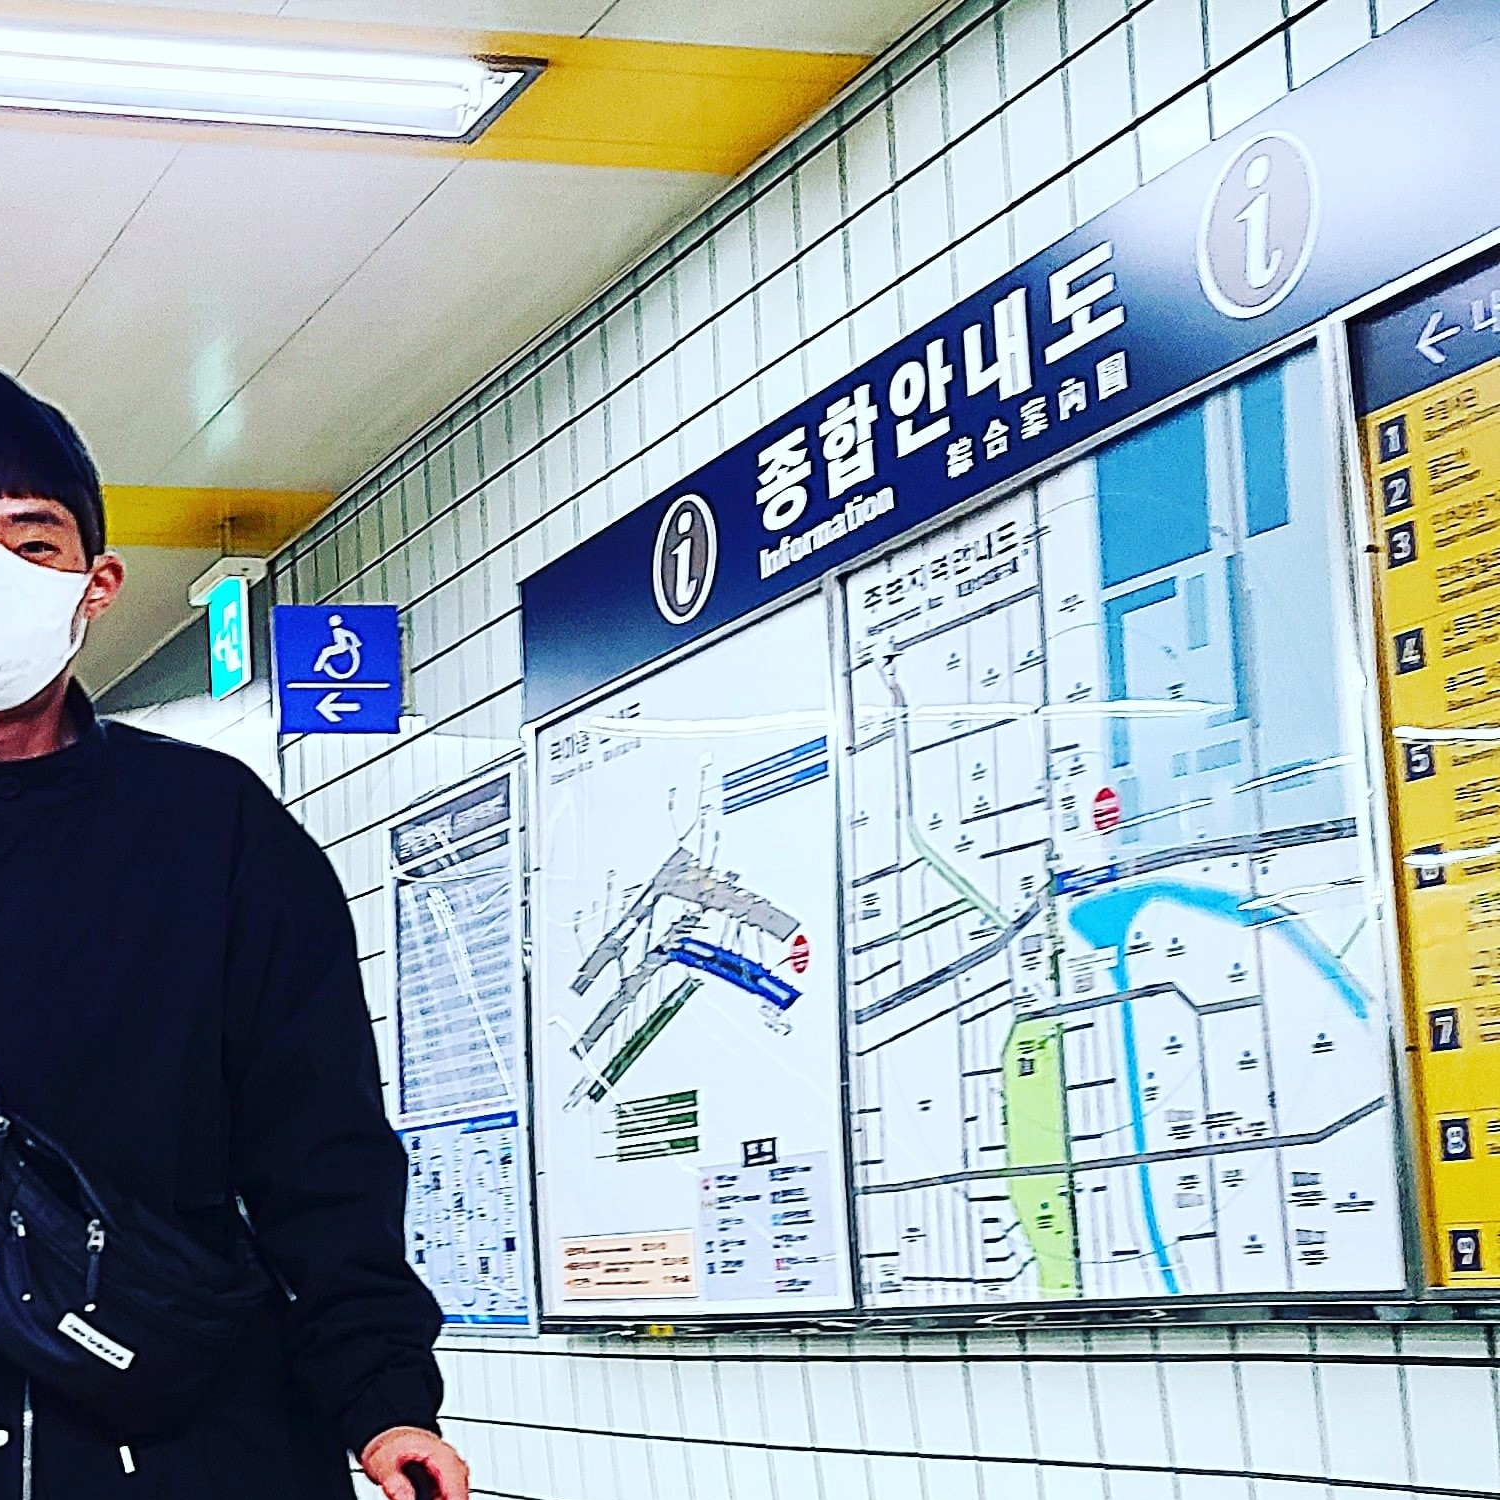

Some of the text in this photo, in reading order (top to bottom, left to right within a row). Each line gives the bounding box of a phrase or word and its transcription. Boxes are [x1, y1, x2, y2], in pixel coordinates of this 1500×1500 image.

[755, 239, 1125, 532] 종합안내도
[1384, 424, 1400, 453] 1
[1386, 478, 1408, 507] 2
[759, 486, 895, 580] Information
[1391, 531, 1412, 560] 3
[1400, 637, 1421, 665] 4
[1409, 743, 1431, 773] 5
[1435, 1015, 1454, 1045] 7
[1446, 1126, 1467, 1155] 8
[1456, 1236, 1476, 1265] 9
